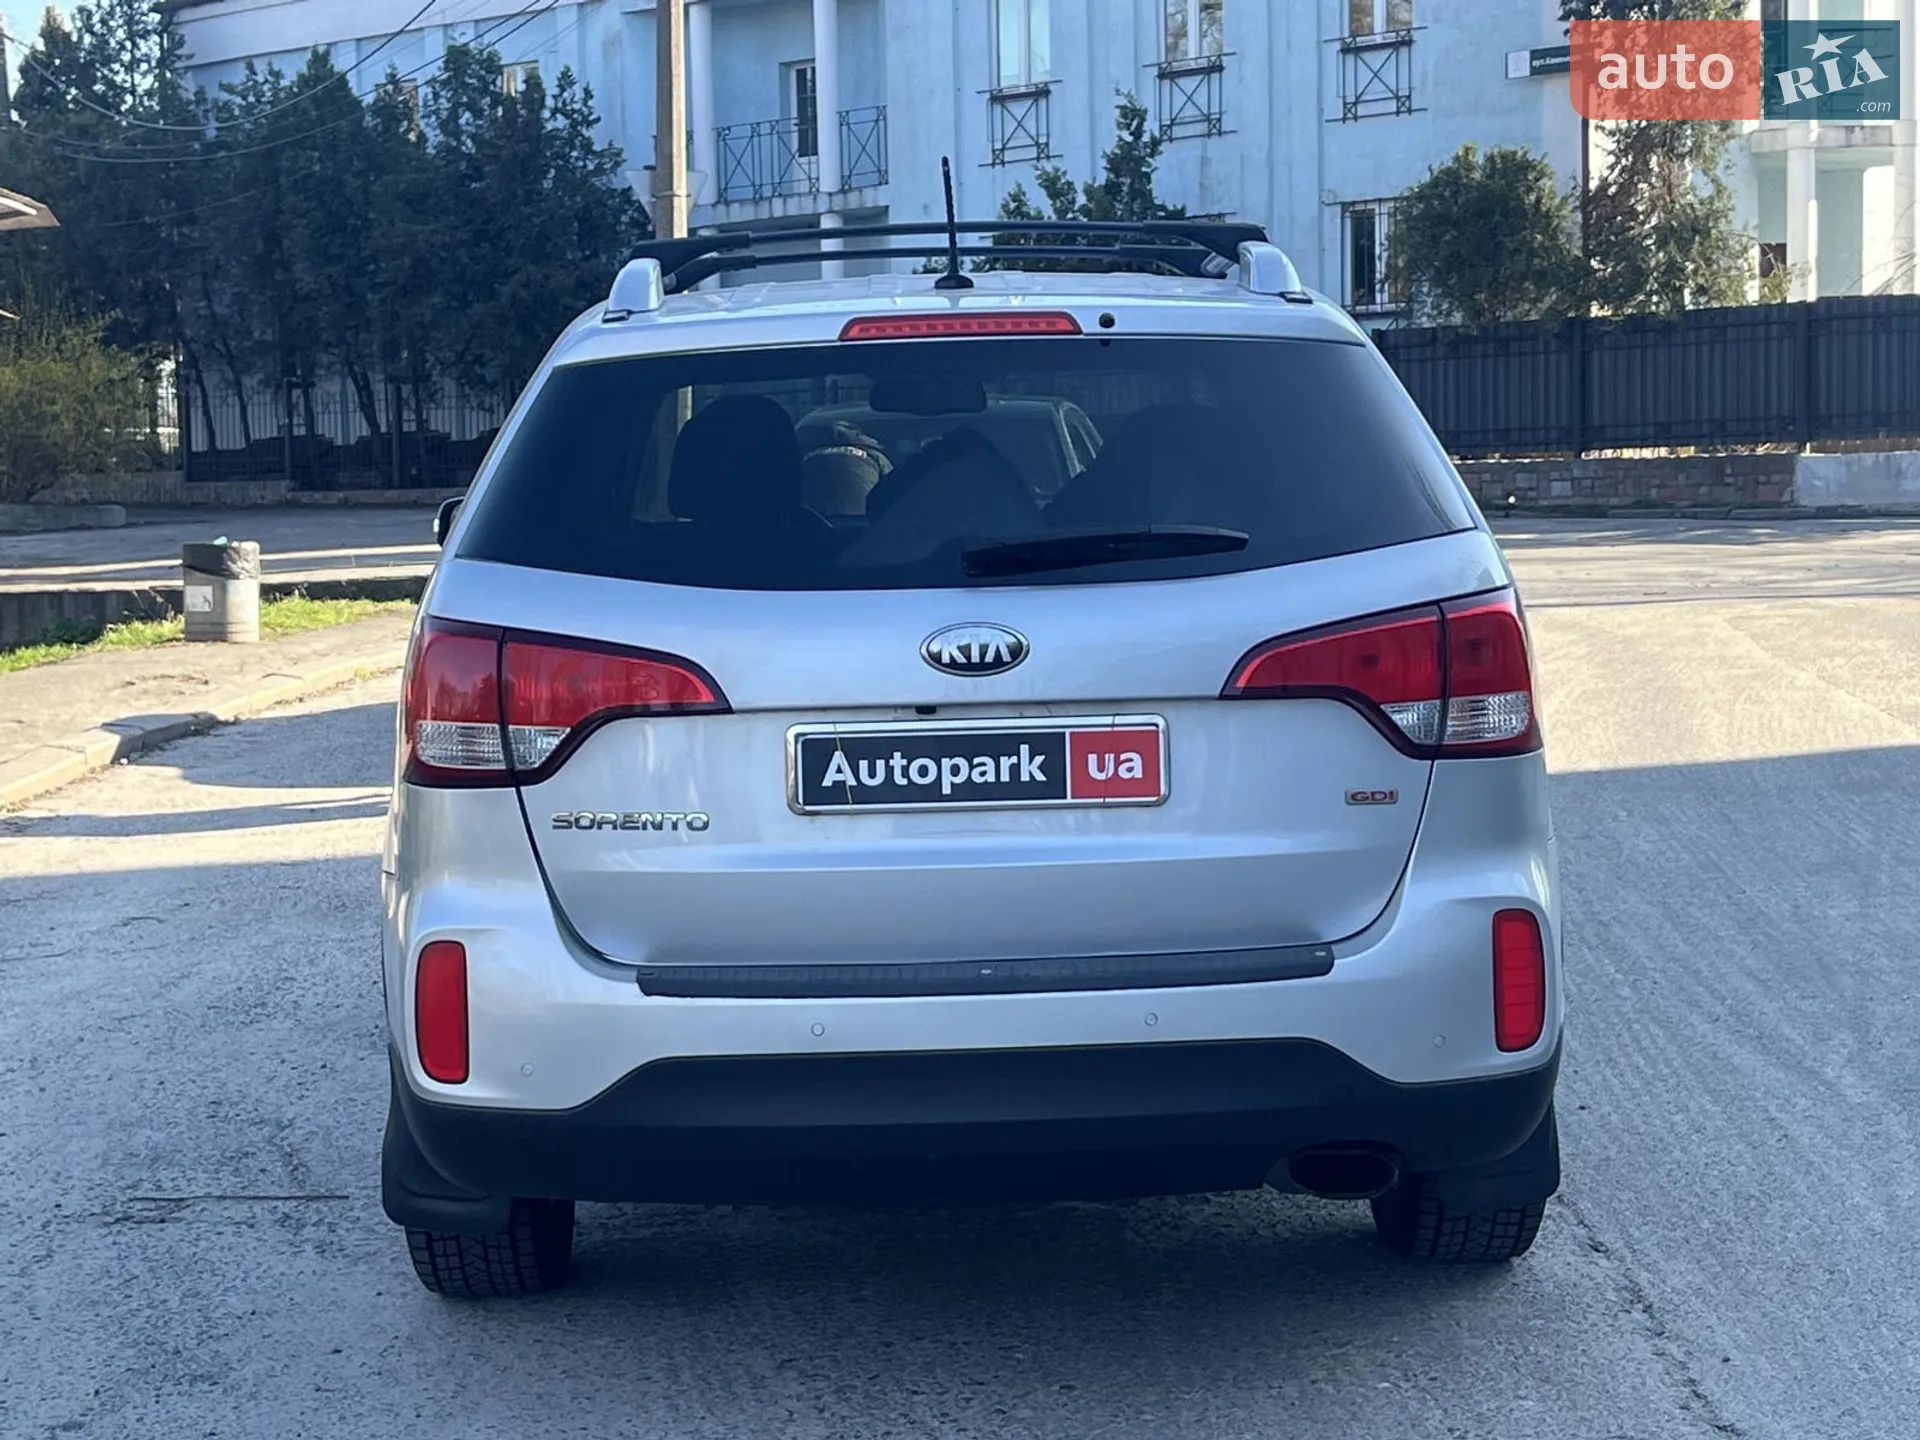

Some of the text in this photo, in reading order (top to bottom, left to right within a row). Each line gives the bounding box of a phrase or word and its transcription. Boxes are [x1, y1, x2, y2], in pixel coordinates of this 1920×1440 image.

[940, 633, 1012, 664] KIA
[821, 743, 1144, 795] Autopark ua
[1350, 790, 1395, 802] GDI
[551, 810, 710, 832] SORENTO
